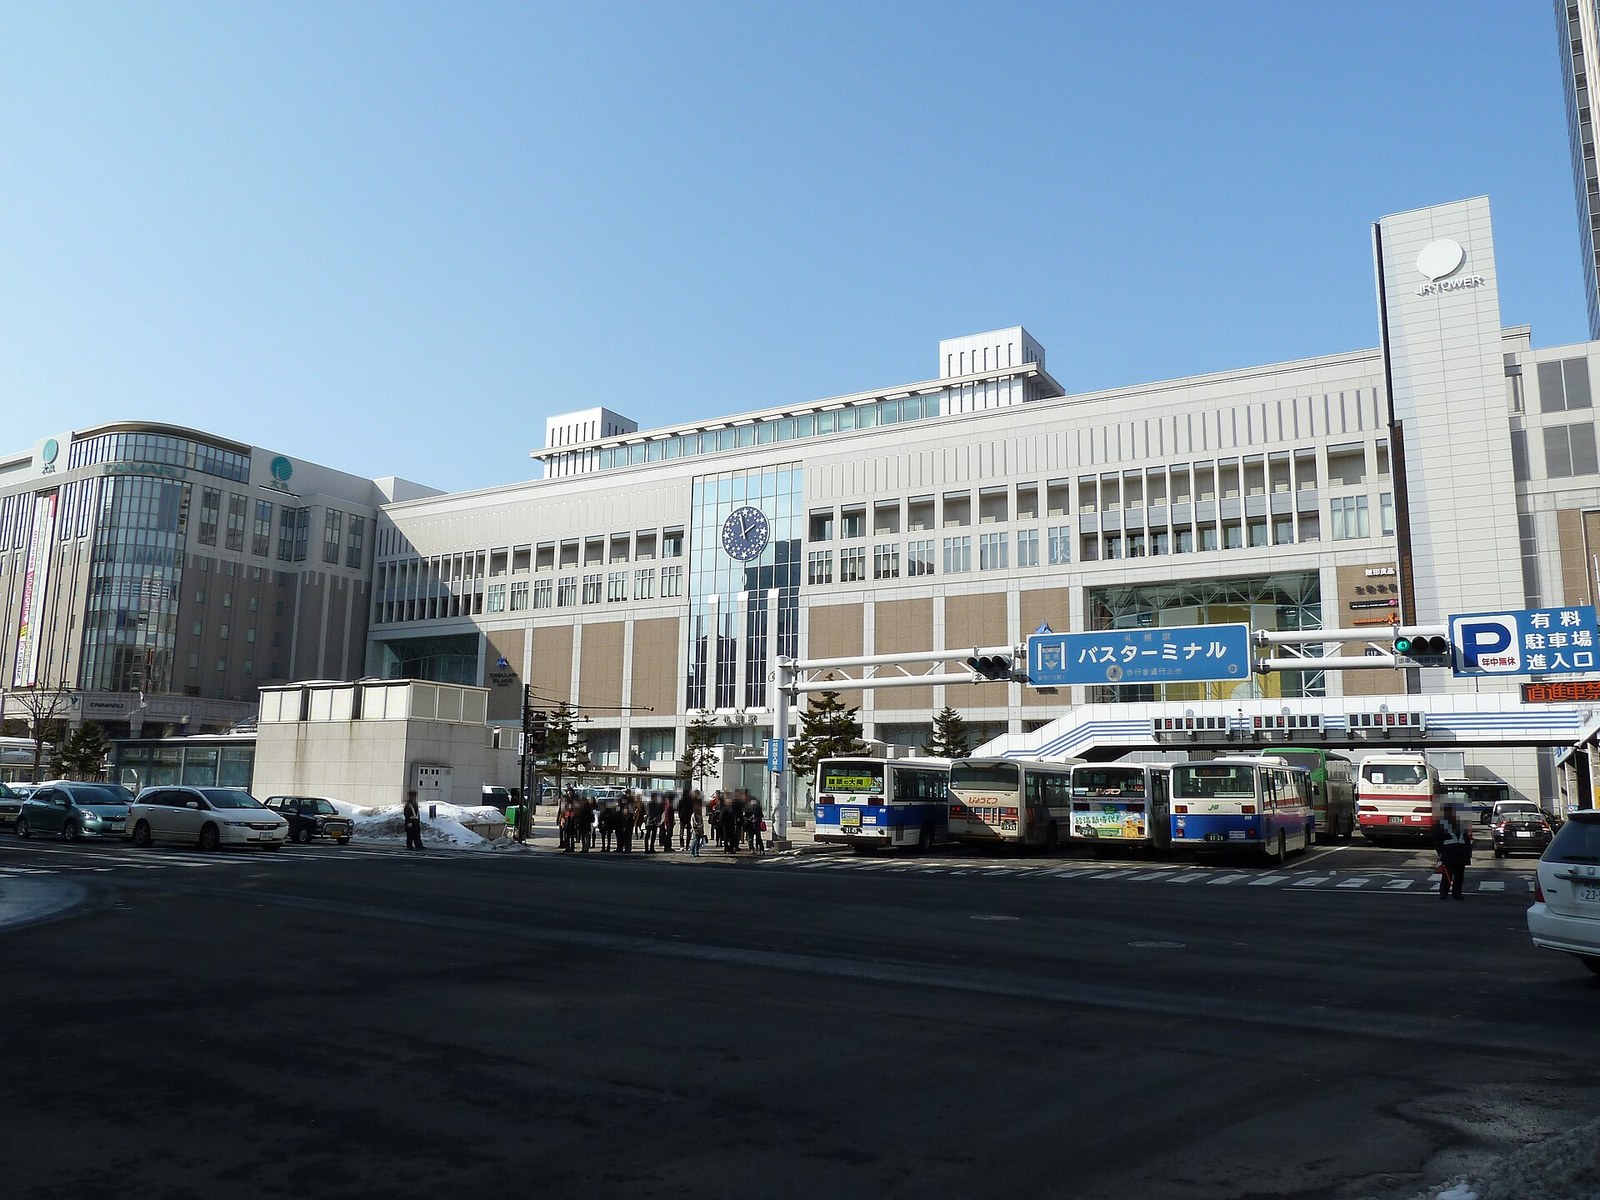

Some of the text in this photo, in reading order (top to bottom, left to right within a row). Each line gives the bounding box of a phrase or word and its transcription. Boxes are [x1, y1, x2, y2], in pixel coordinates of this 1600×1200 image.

[1433, 275, 1482, 291] TOWER
[1530, 610, 1582, 629] 有料
[1461, 622, 1512, 668] P
[1525, 630, 1592, 650] 駐車場
[1078, 641, 1227, 664] バスターミナル
[1481, 656, 1516, 667] 年中無休
[1526, 651, 1594, 671] 進入口
